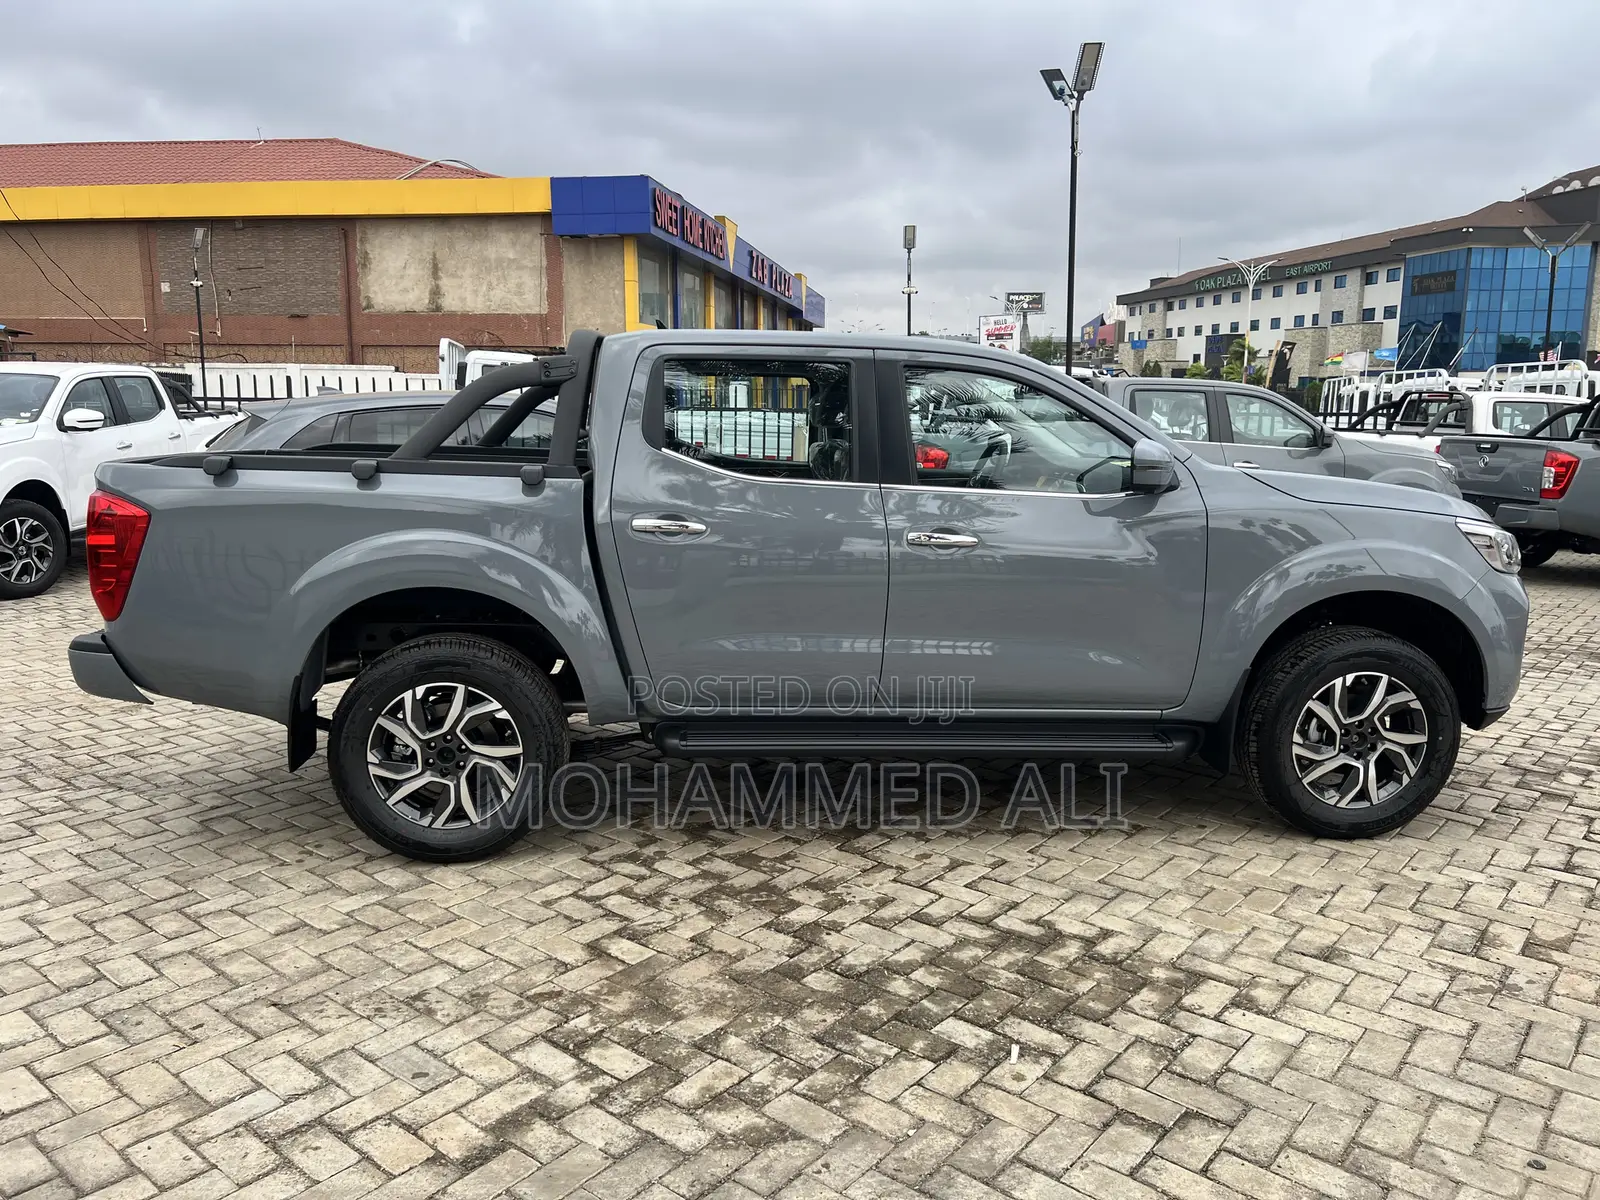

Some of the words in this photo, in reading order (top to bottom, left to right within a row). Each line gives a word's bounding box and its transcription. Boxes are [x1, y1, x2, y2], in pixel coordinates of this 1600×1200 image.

[654, 187, 680, 237] SWEET
[683, 206, 703, 249] HOME
[703, 218, 725, 260] KITCHEN
[1285, 266, 1301, 277] EAST
[1303, 260, 1332, 273] AIRPORT
[771, 263, 793, 299] PLAZA
[1200, 278, 1216, 291] OAK
[1217, 273, 1242, 289] PLAZA
[985, 324, 1016, 336] SUMMER
